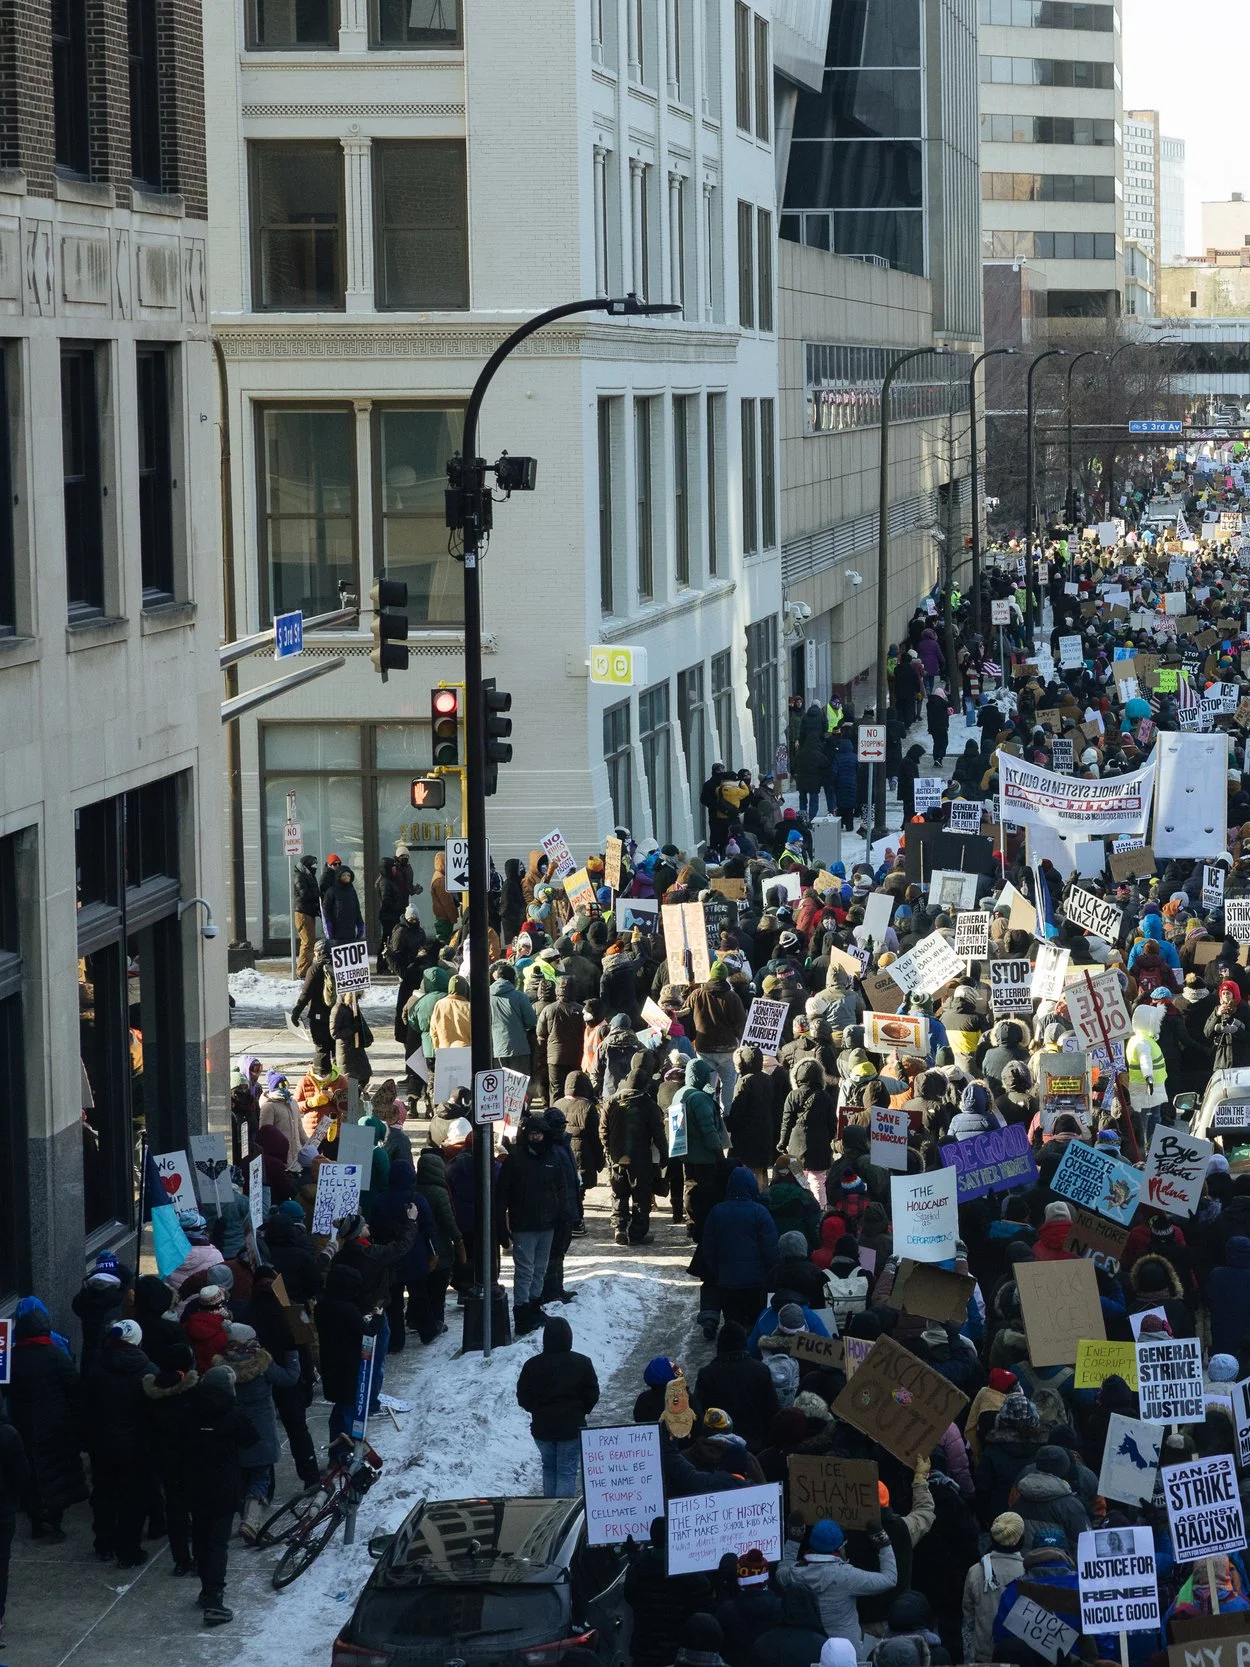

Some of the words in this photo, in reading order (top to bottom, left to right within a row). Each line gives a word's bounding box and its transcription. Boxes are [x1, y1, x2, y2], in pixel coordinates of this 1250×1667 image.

[278, 627, 282, 648] S
[284, 625, 293, 646] 3rd
[294, 623, 300, 644] St
[596, 658, 605, 669] K
[867, 729, 877, 738] NO
[861, 740, 884, 748] STOPPING
[288, 828, 297, 836] NO
[453, 843, 468, 855] ON
[1072, 888, 1101, 915] FUCK
[1101, 904, 1121, 926] OFF
[1069, 904, 1095, 929] NAZI
[1095, 920, 1111, 938] ICE
[333, 943, 366, 968] STOP
[321, 1165, 338, 1176] ICE
[320, 1178, 357, 1188] MELTS
[910, 1184, 934, 1198] THE
[907, 1197, 949, 1212] HOLOCAUST
[1084, 1346, 1124, 1357] INEPT
[1138, 1344, 1198, 1363] GENERAL
[1083, 1358, 1134, 1368] CORRUPT
[1140, 1362, 1200, 1382] STRIKE:
[1142, 1384, 1160, 1401] THE
[1162, 1382, 1186, 1400] PATH
[1188, 1381, 1202, 1397] TO
[1142, 1400, 1204, 1419] JUSTICE
[599, 1434, 621, 1446] PRAY
[628, 1431, 653, 1444] THAT
[609, 1449, 653, 1461] BEAUTIFUL
[608, 1463, 629, 1474] WILL
[632, 1462, 645, 1472] BE
[1167, 1460, 1230, 1483] JAN.23
[590, 1478, 608, 1489] THE
[610, 1477, 637, 1487] NAME
[641, 1475, 653, 1485] OF
[1169, 1471, 1235, 1511] STRIKE
[602, 1491, 642, 1503] TRUMP'S
[798, 1476, 873, 1507] SHAME
[591, 1507, 641, 1520] CELLMATE
[644, 1504, 656, 1515] IN
[671, 1499, 699, 1515] THIS
[705, 1496, 716, 1509] IS
[816, 1506, 833, 1518] ON
[1178, 1505, 1237, 1524] AGAINST
[671, 1517, 693, 1530] THE
[696, 1511, 719, 1526] PART
[723, 1508, 735, 1520] OF
[737, 1502, 776, 1518] HISTORY
[605, 1522, 651, 1537] PRISON
[671, 1529, 693, 1541] THAT
[694, 1525, 719, 1538] MAKES
[723, 1520, 745, 1532] SCHOOL
[746, 1517, 761, 1528] KIDS
[762, 1514, 778, 1525] ASK
[1175, 1513, 1243, 1549] RACISM
[734, 1541, 754, 1554] STOP
[755, 1536, 778, 1551] THEM?
[1081, 1558, 1128, 1580] JUSTICE
[1130, 1556, 1154, 1574] FOR
[1083, 1586, 1156, 1603] RENEE
[1022, 1601, 1070, 1643] FUCK
[1084, 1605, 1125, 1625] NICOLE
[1127, 1603, 1158, 1620] GOOD
[1023, 1620, 1052, 1649] ICE
[1184, 1645, 1223, 1667] MY
